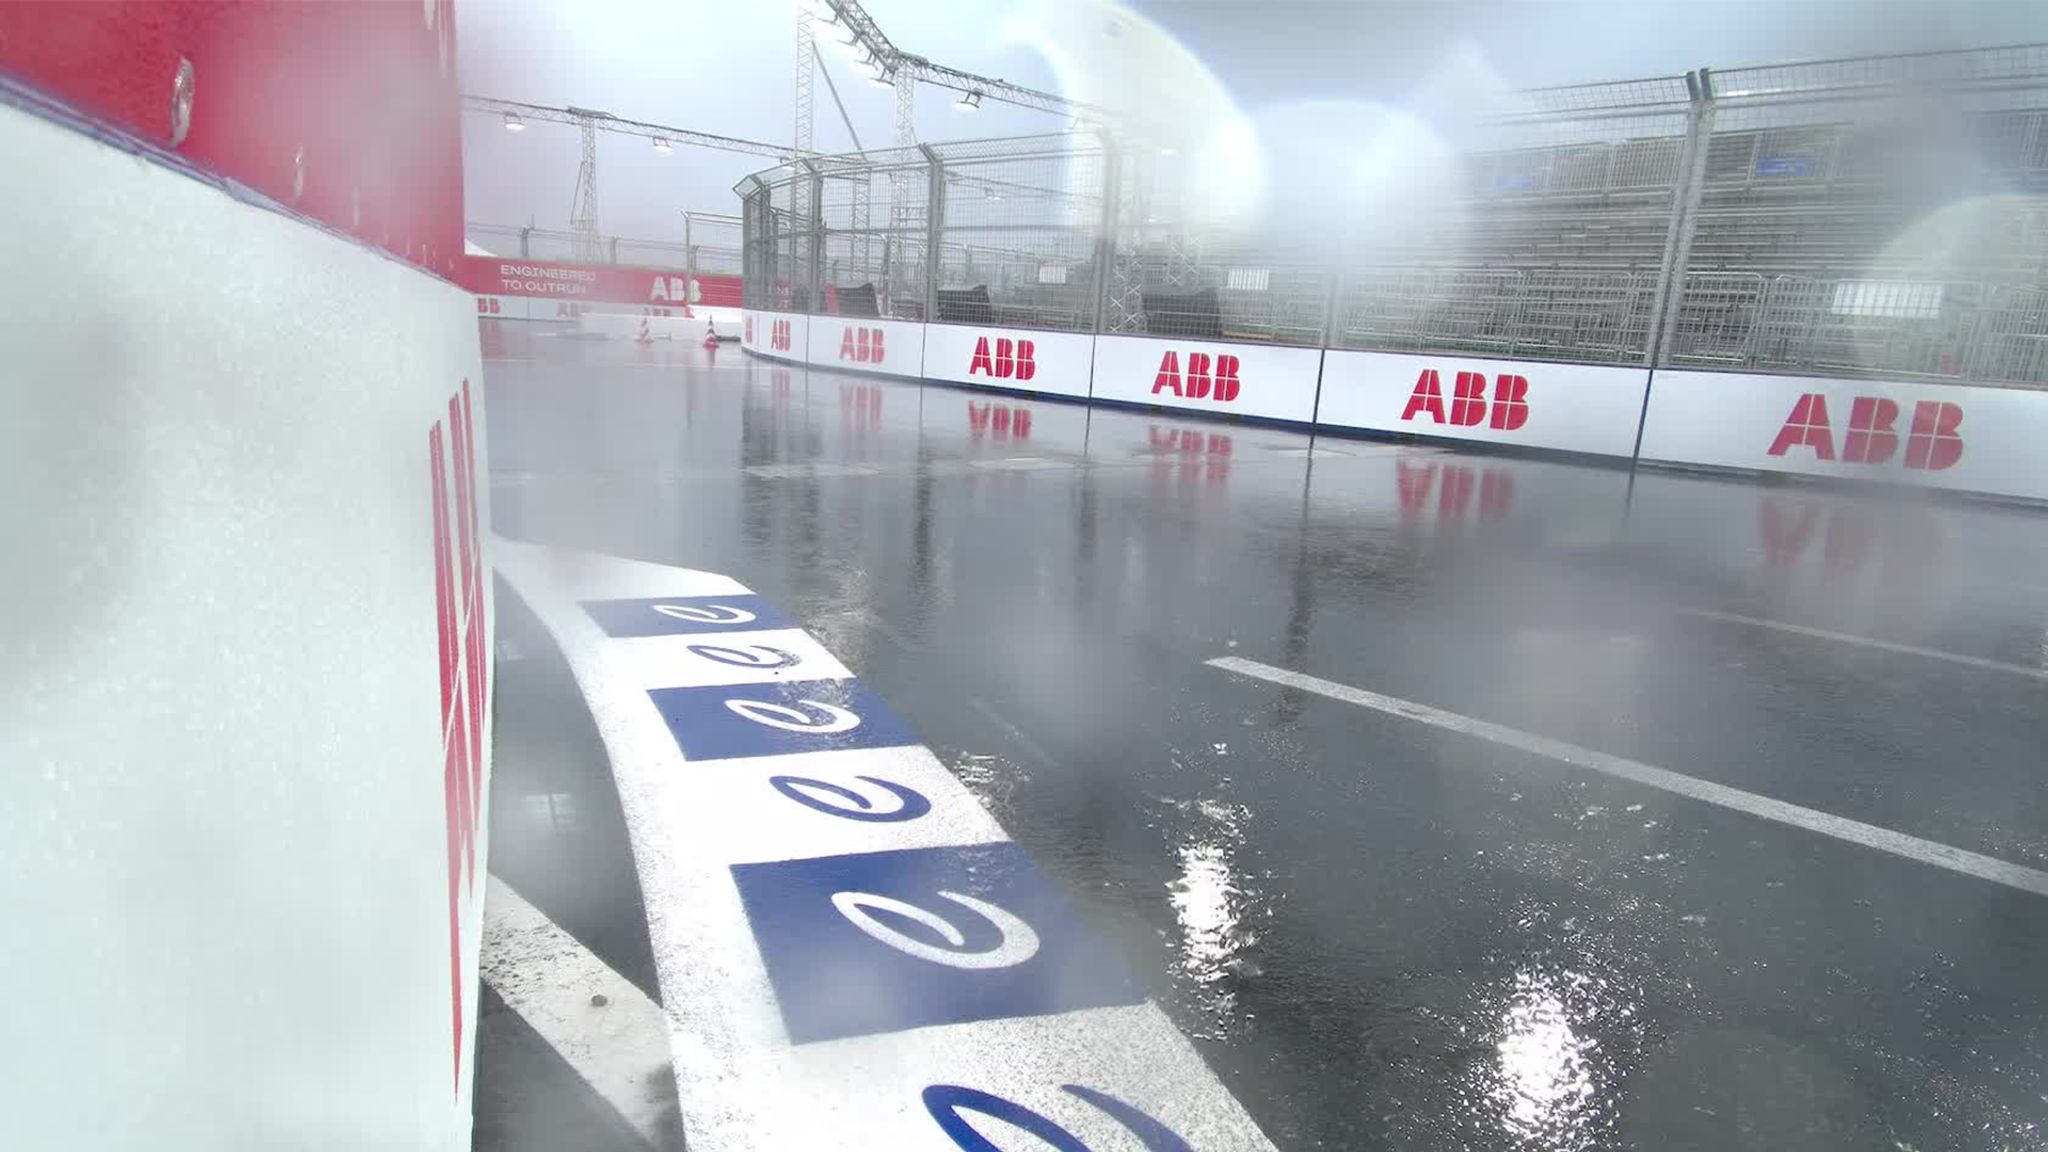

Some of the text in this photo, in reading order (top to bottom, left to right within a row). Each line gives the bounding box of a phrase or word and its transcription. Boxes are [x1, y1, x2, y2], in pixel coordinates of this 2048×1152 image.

[500, 264, 597, 281] ENGINEERED
[501, 279, 587, 295] TO OUTRUN
[649, 275, 702, 303] ABB
[771, 319, 791, 351] ABB
[840, 326, 886, 364] ABB
[968, 336, 1037, 382] ABB
[1151, 350, 1241, 403] ABB
[1400, 369, 1529, 431] ABB
[1767, 393, 1965, 471] ABB
